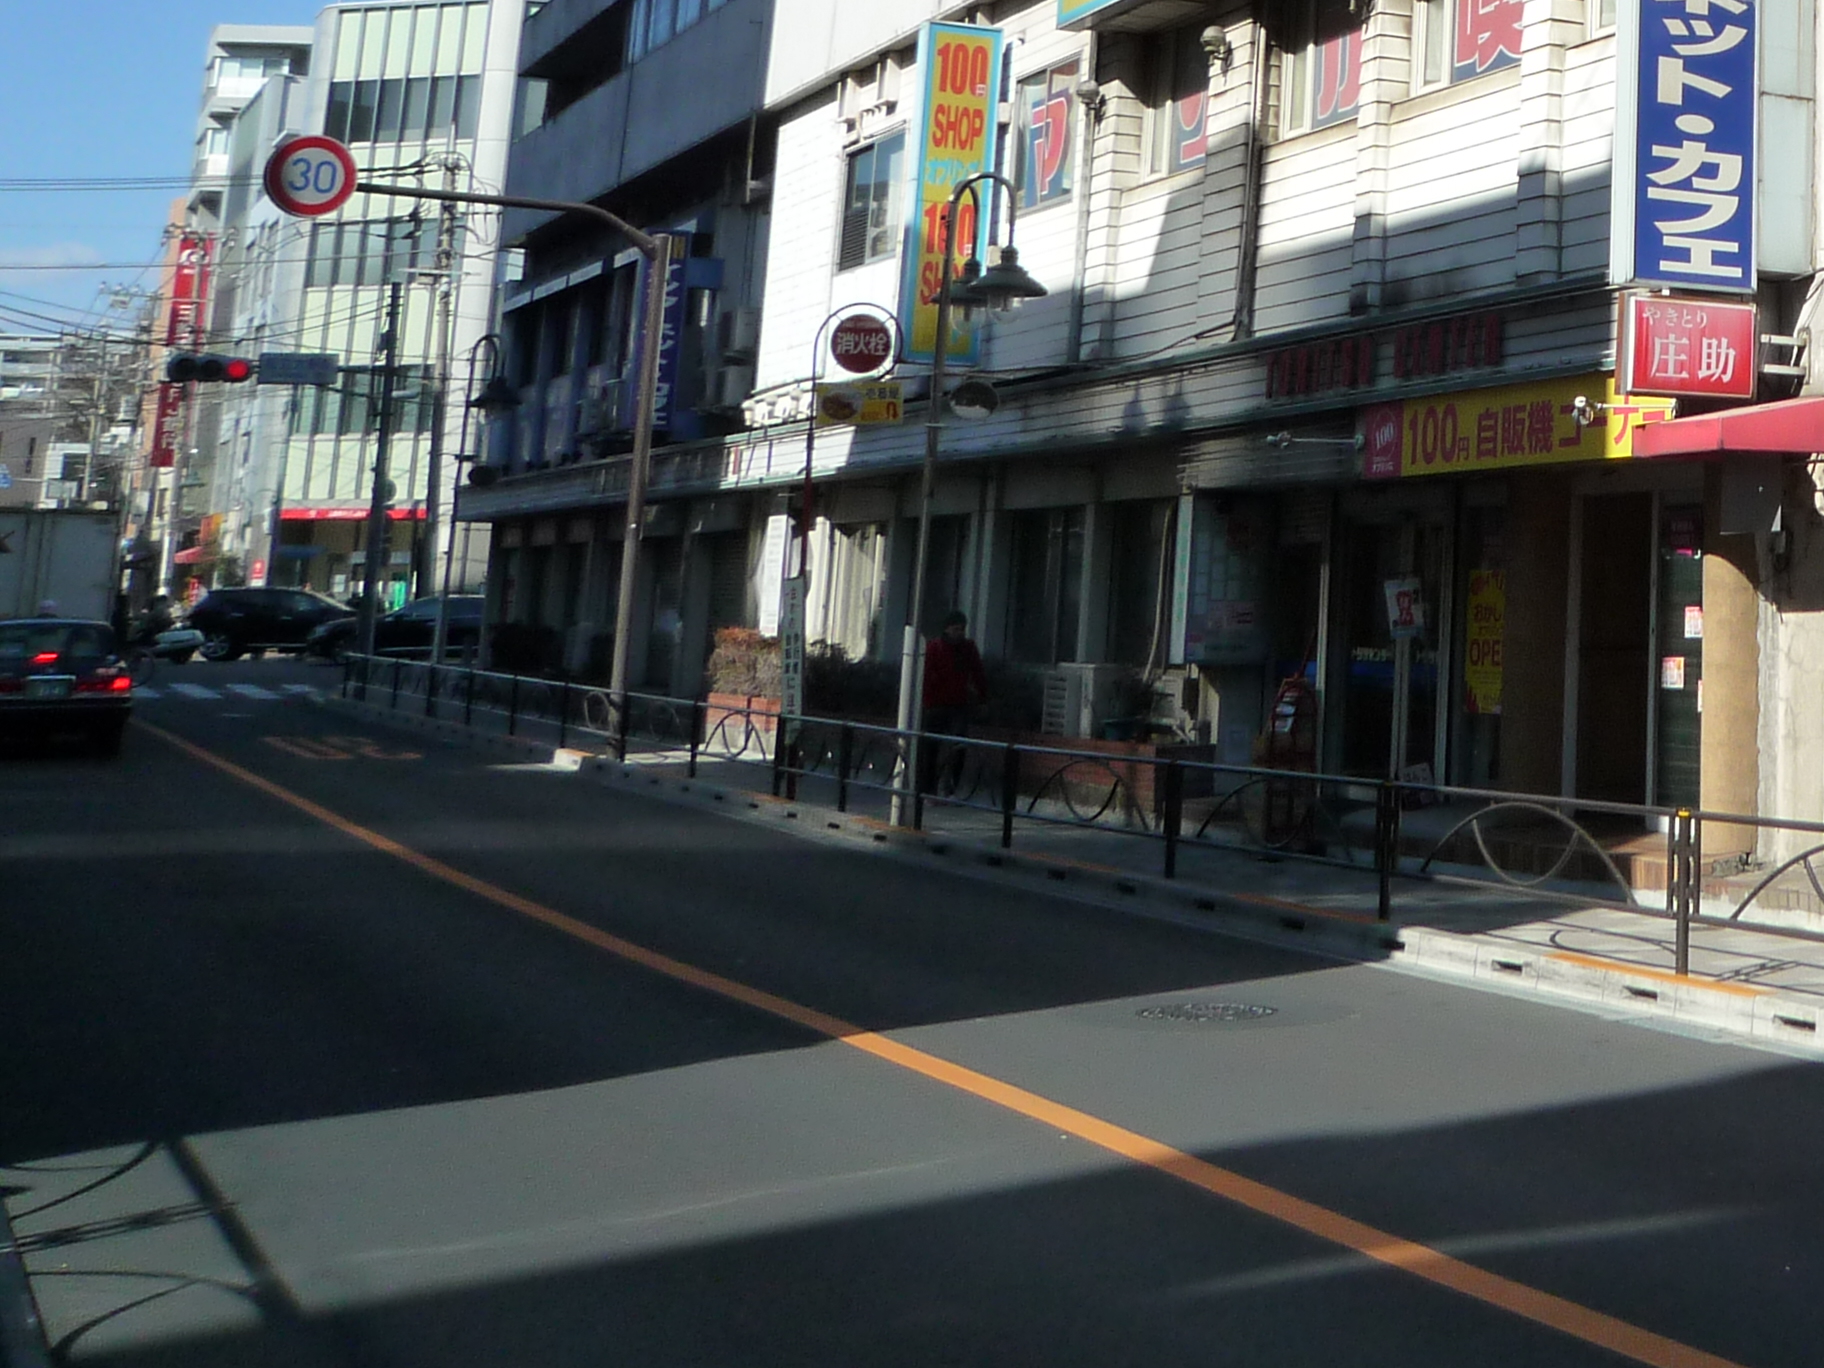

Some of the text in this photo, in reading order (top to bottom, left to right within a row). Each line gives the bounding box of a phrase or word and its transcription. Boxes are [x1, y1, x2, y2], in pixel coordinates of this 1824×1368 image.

[932, 103, 985, 151] SHOP
[288, 157, 338, 194] 30
[1641, 305, 1708, 328] やきとり
[836, 332, 887, 356] 消火栓
[1650, 335, 1736, 384] 庄助
